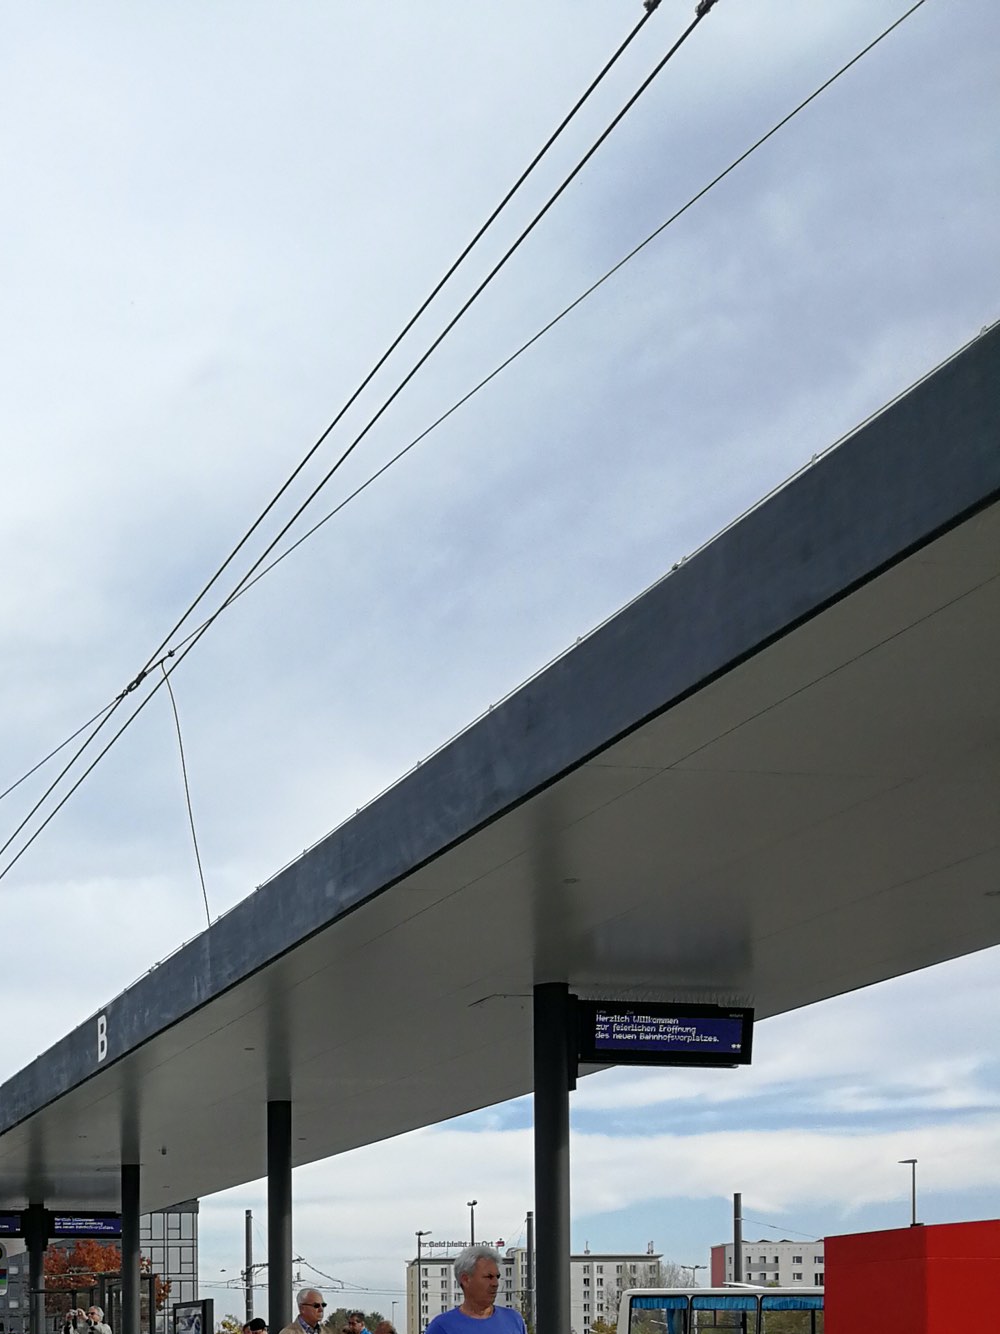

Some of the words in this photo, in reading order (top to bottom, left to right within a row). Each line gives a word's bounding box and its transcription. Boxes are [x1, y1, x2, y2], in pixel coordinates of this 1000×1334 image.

[595, 1014, 630, 1022] Herzlich
[633, 1015, 679, 1024] Willkommen
[613, 1023, 656, 1033] feierlichen
[659, 1024, 697, 1034] Eröffnung
[97, 1014, 108, 1063] B
[595, 1031, 610, 1039] des
[612, 1032, 637, 1040] neuen
